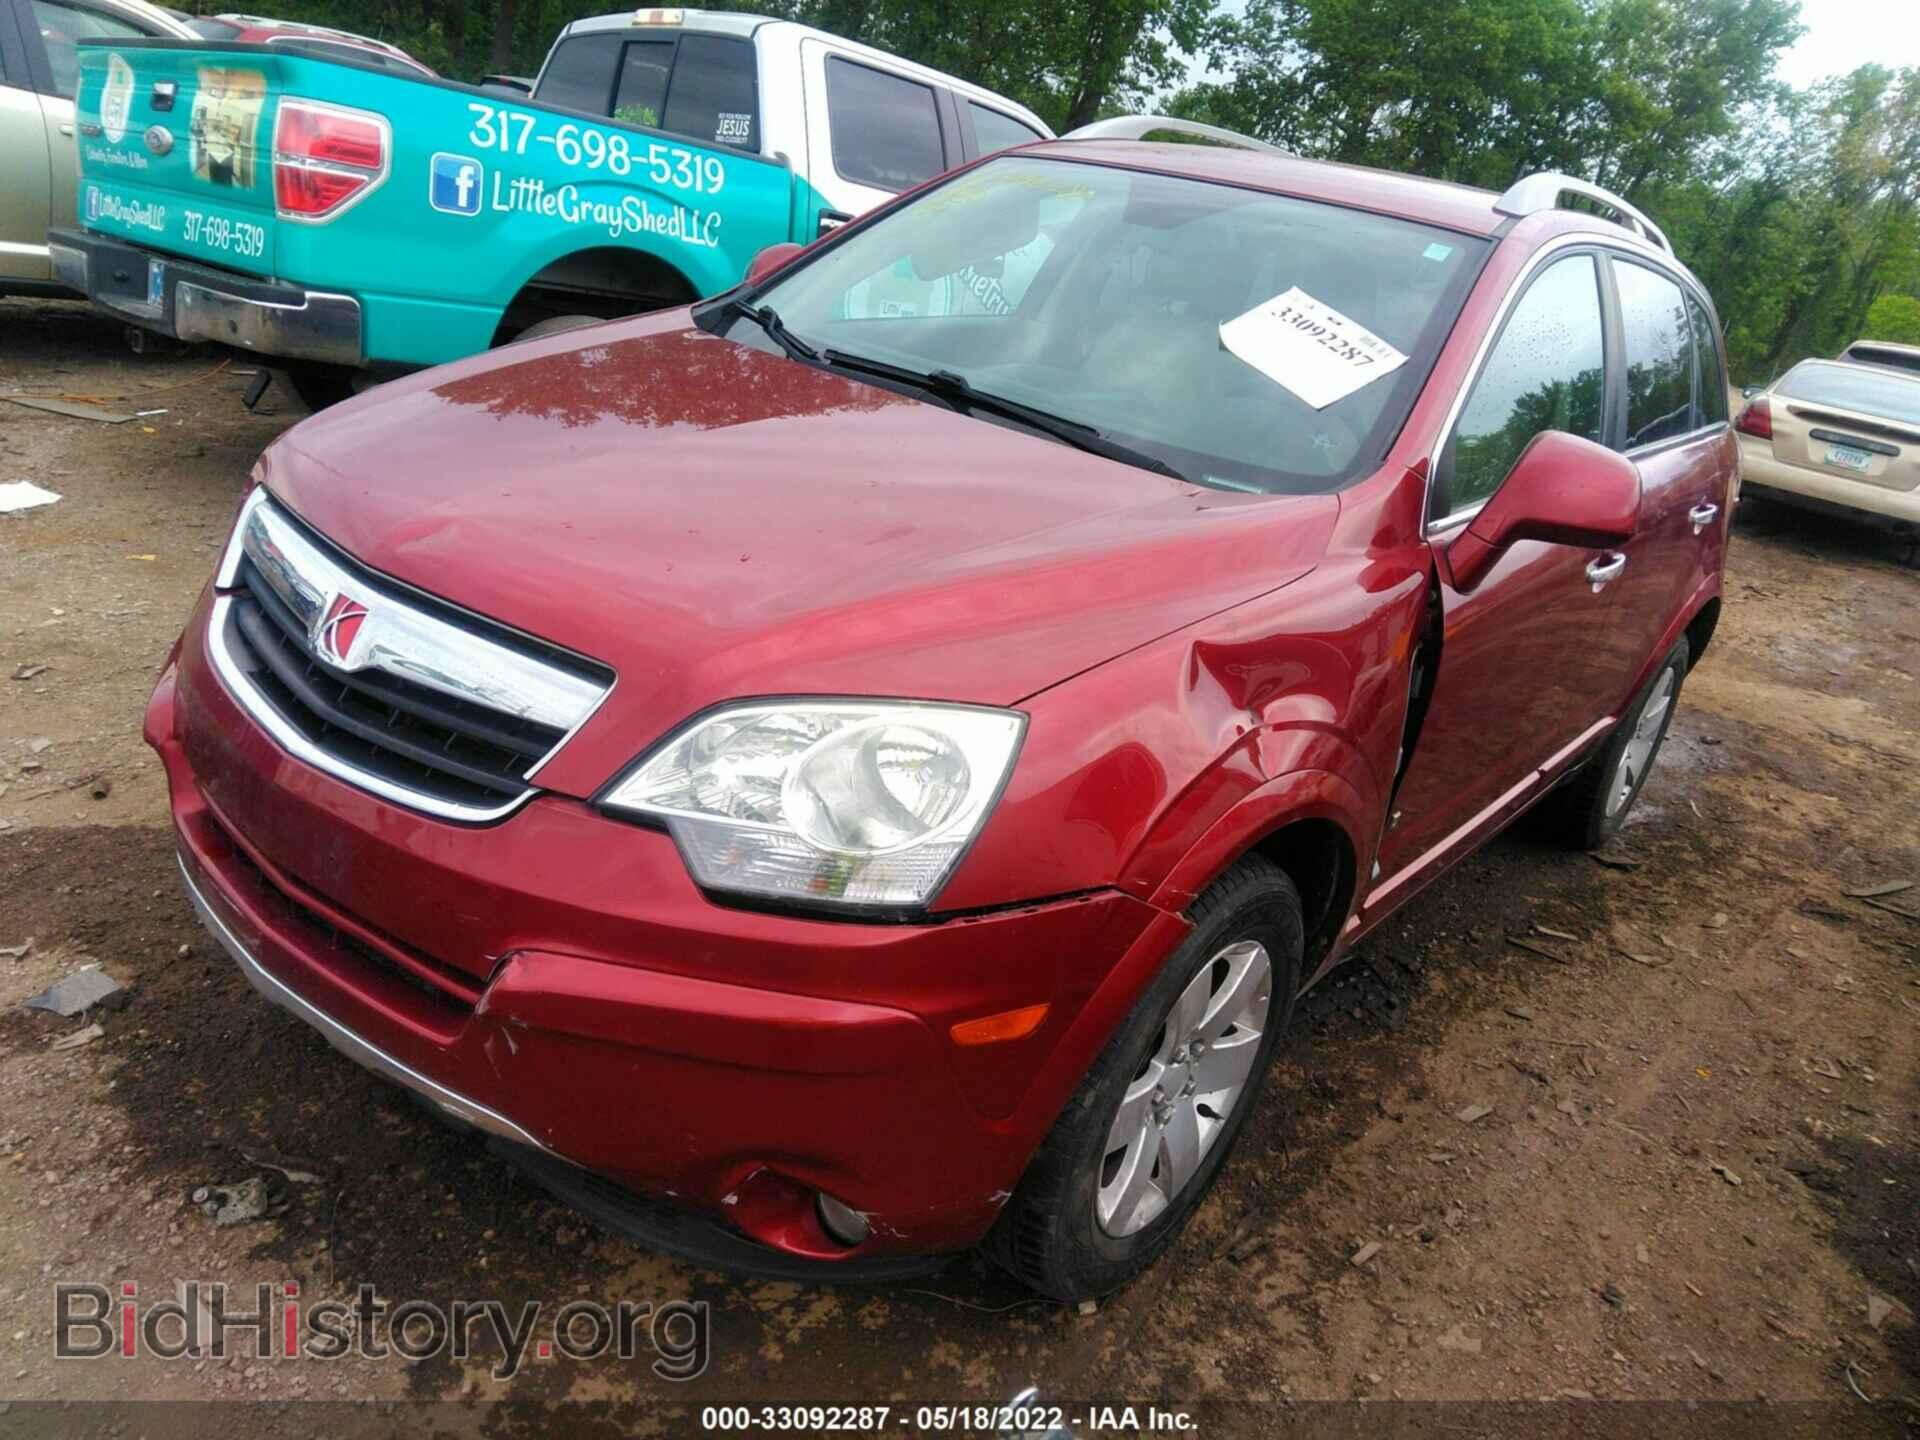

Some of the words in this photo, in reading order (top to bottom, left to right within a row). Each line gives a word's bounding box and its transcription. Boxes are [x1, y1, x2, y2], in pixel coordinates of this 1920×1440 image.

[468, 104, 725, 195] 317-698-5319
[716, 119, 750, 137] JESUS
[183, 210, 265, 257] 317-698-5319
[492, 170, 722, 248] LittleGrayShedLLC
[1271, 306, 1376, 367] 33092287
